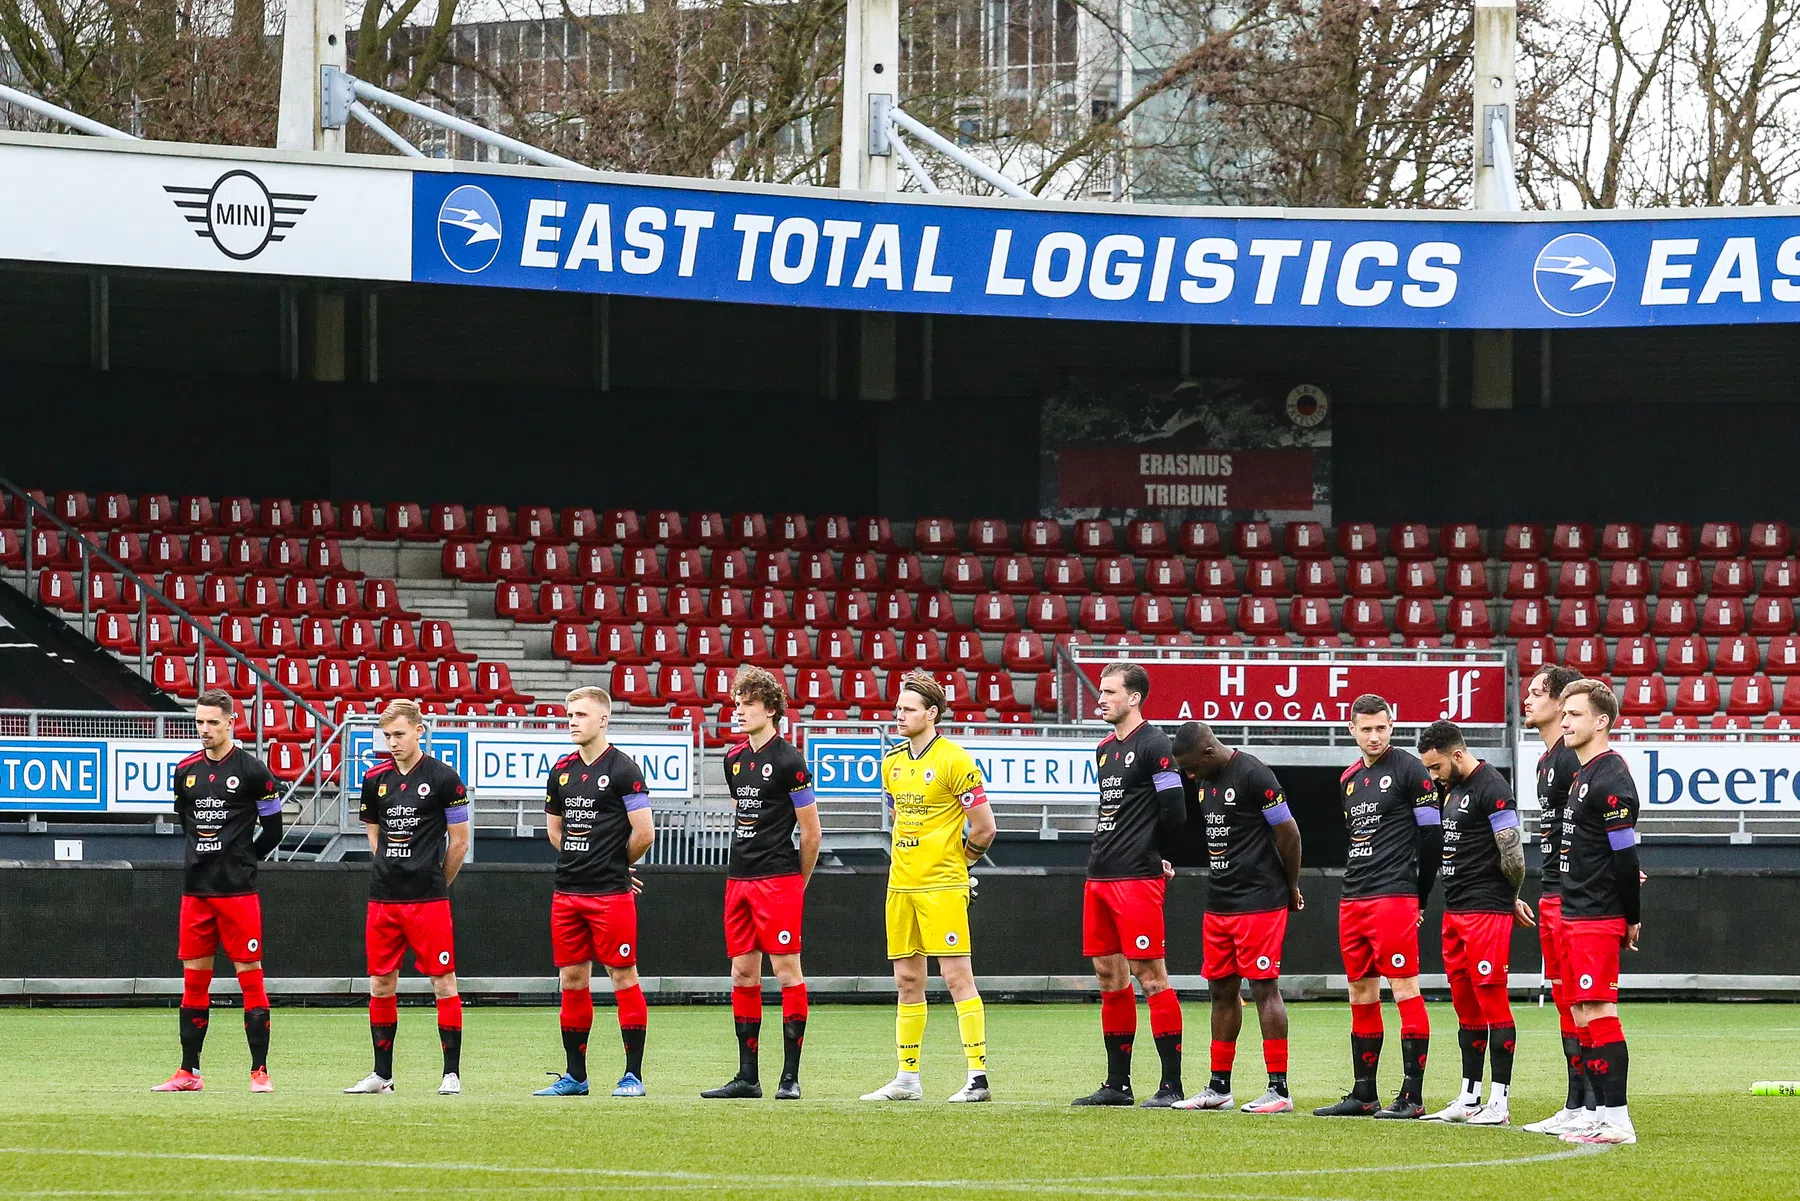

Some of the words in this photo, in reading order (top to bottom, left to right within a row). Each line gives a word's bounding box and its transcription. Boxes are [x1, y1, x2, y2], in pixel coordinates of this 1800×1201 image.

[217, 203, 264, 227] MINI
[520, 198, 715, 278] EAST
[733, 213, 954, 293] TOTAL
[984, 228, 1461, 308] LOGISTICS
[1640, 235, 1800, 306] EAS
[1139, 453, 1233, 477] ERASMUS
[1144, 484, 1228, 506] TRIBUNE
[1178, 701, 1397, 721] ADVOCATN
[1, 759, 93, 791] TONE
[821, 754, 878, 783] STO
[975, 759, 1099, 784] NTERIM
[737, 785, 760, 797] esther
[896, 792, 926, 804] esther
[195, 796, 226, 808] esther
[565, 795, 595, 808] esther
[1350, 801, 1379, 816] esther
[193, 810, 229, 822] vergeer
[386, 805, 417, 817] esther
[1205, 812, 1226, 824] sther
[195, 841, 222, 852] DSW
[564, 841, 590, 851] DSW
